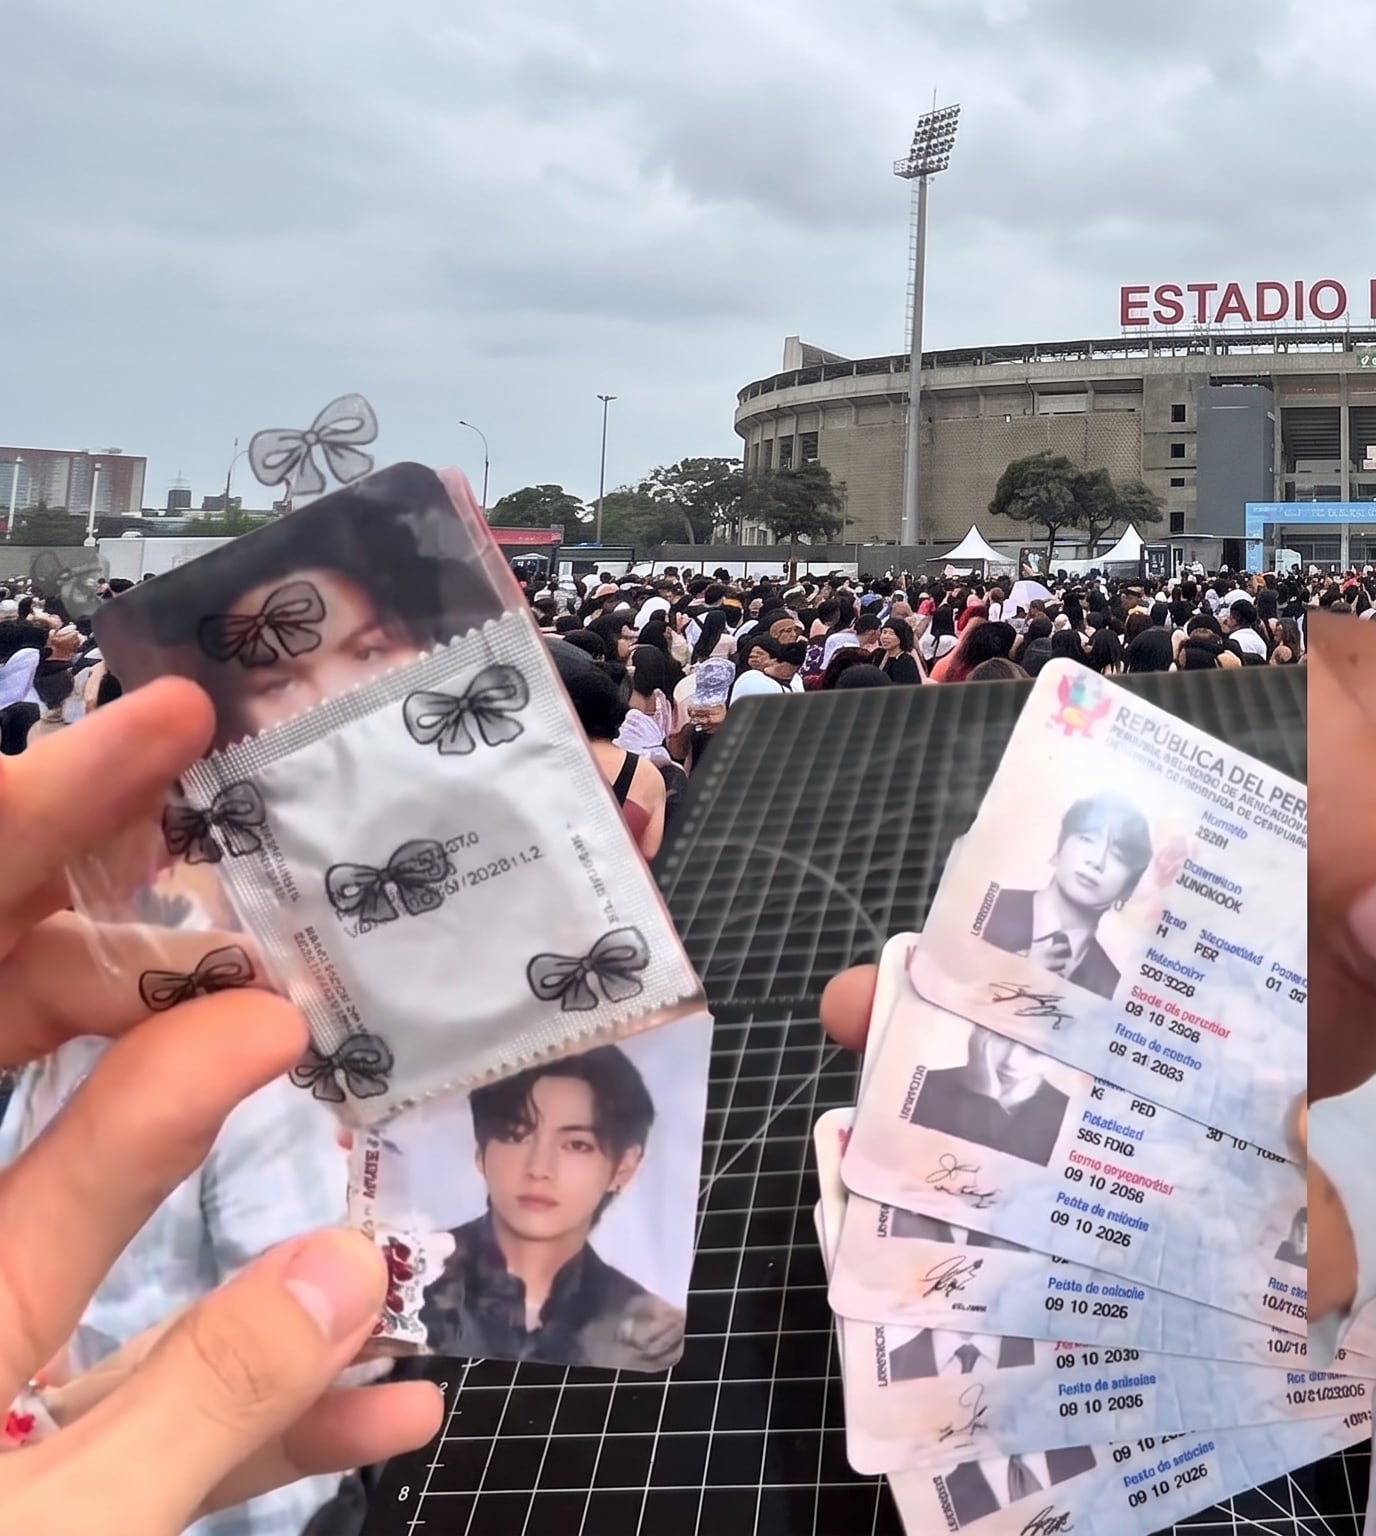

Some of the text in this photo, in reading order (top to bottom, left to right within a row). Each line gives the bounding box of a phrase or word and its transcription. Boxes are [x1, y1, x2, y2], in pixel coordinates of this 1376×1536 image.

[1119, 278, 1347, 327] ESTADIO
[1115, 705, 1225, 778] REPÚBLICA
[1227, 765, 1266, 799] DEL
[1268, 785, 1307, 823] PER
[1176, 873, 1244, 914] JUNGKOOK
[1194, 942, 1220, 963] PER
[1063, 1165, 1084, 1183] 09
[1089, 1174, 1107, 1191] 10
[1049, 1209, 1070, 1228] 09
[1075, 1217, 1093, 1235] 10
[1044, 1295, 1130, 1320] 09 10 2026
[1055, 1353, 1076, 1370] 09
[1081, 1351, 1100, 1367] 10
[1084, 1398, 1103, 1415] 10
[1112, 1445, 1132, 1464] 09
[1137, 1436, 1156, 1453] 10
[397, 1485, 411, 1501] 8
[1128, 1463, 1209, 1508] 09 10 2026
